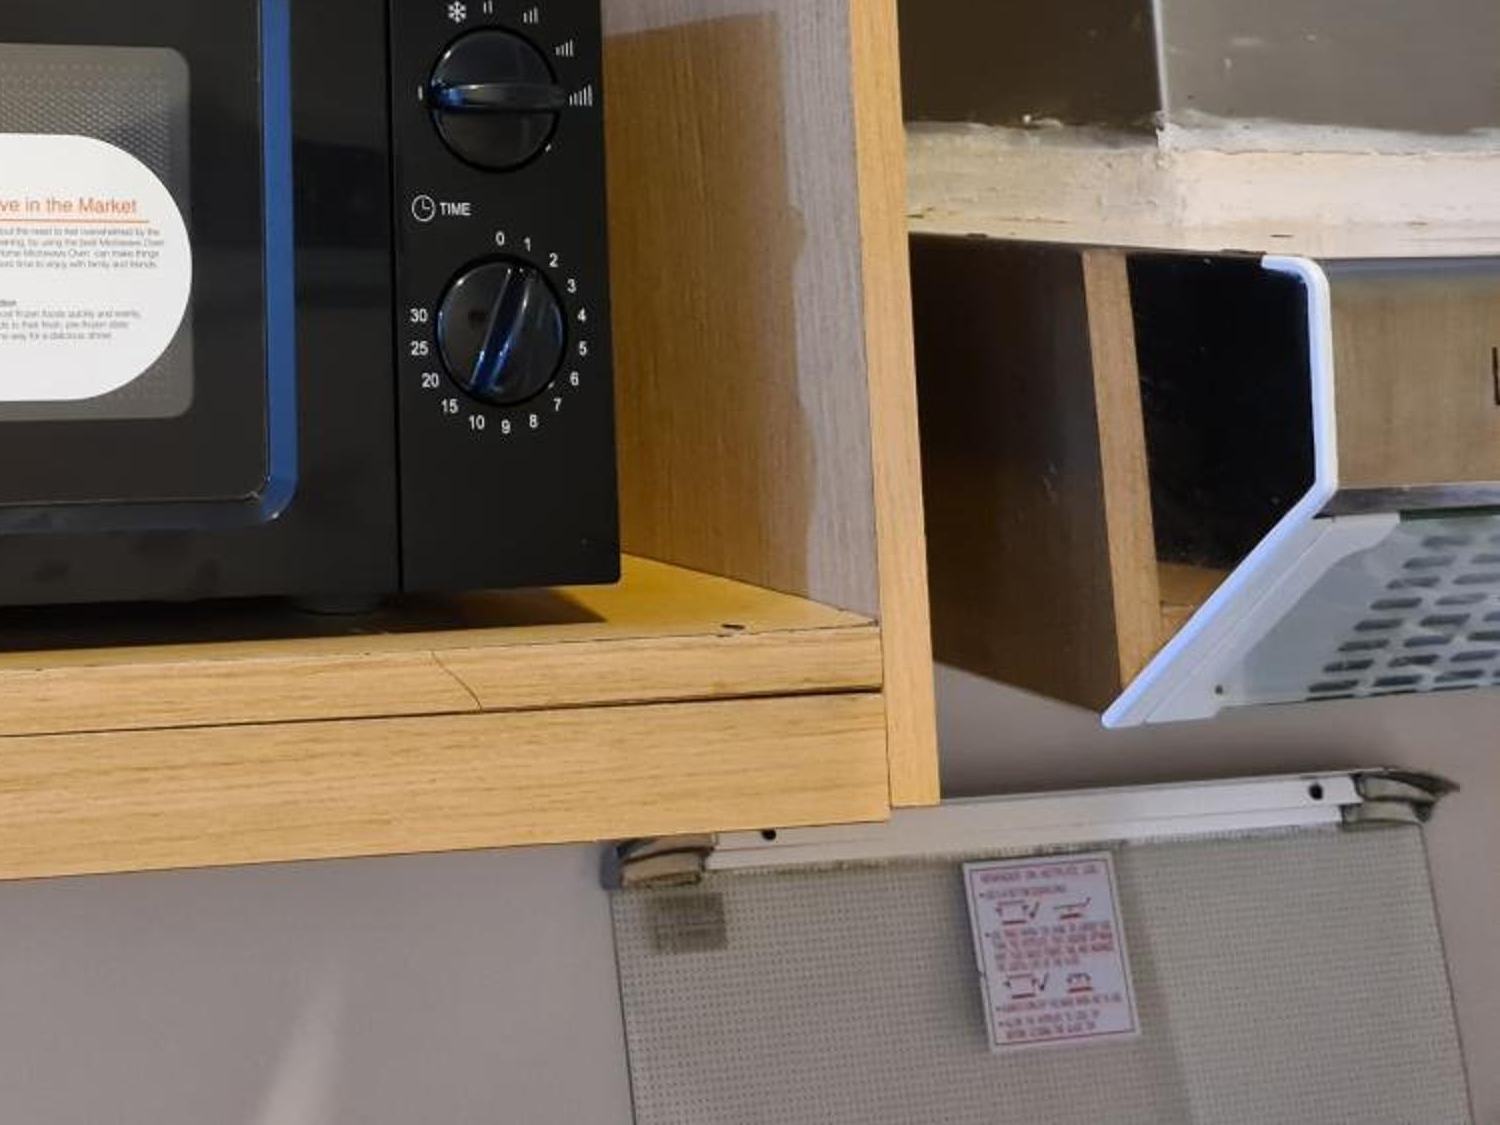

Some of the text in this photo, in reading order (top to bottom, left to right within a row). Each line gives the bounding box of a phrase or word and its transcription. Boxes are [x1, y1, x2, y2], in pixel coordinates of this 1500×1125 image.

[25, 195, 40, 212] in
[45, 196, 73, 213] the
[79, 196, 137, 214] Market
[439, 201, 472, 216] TIME
[495, 231, 505, 246] 0
[523, 237, 532, 252] 1
[549, 253, 559, 268] 2
[567, 278, 577, 293] 3
[410, 308, 428, 323] 30
[577, 307, 586, 322] 4
[411, 341, 429, 356] 25
[579, 341, 588, 356] 5
[421, 373, 439, 388] 20
[570, 371, 579, 386] 6
[442, 399, 459, 414] 15
[553, 398, 562, 411] 7
[469, 415, 485, 430] 10
[501, 419, 511, 434] 9
[529, 414, 539, 429] 8
